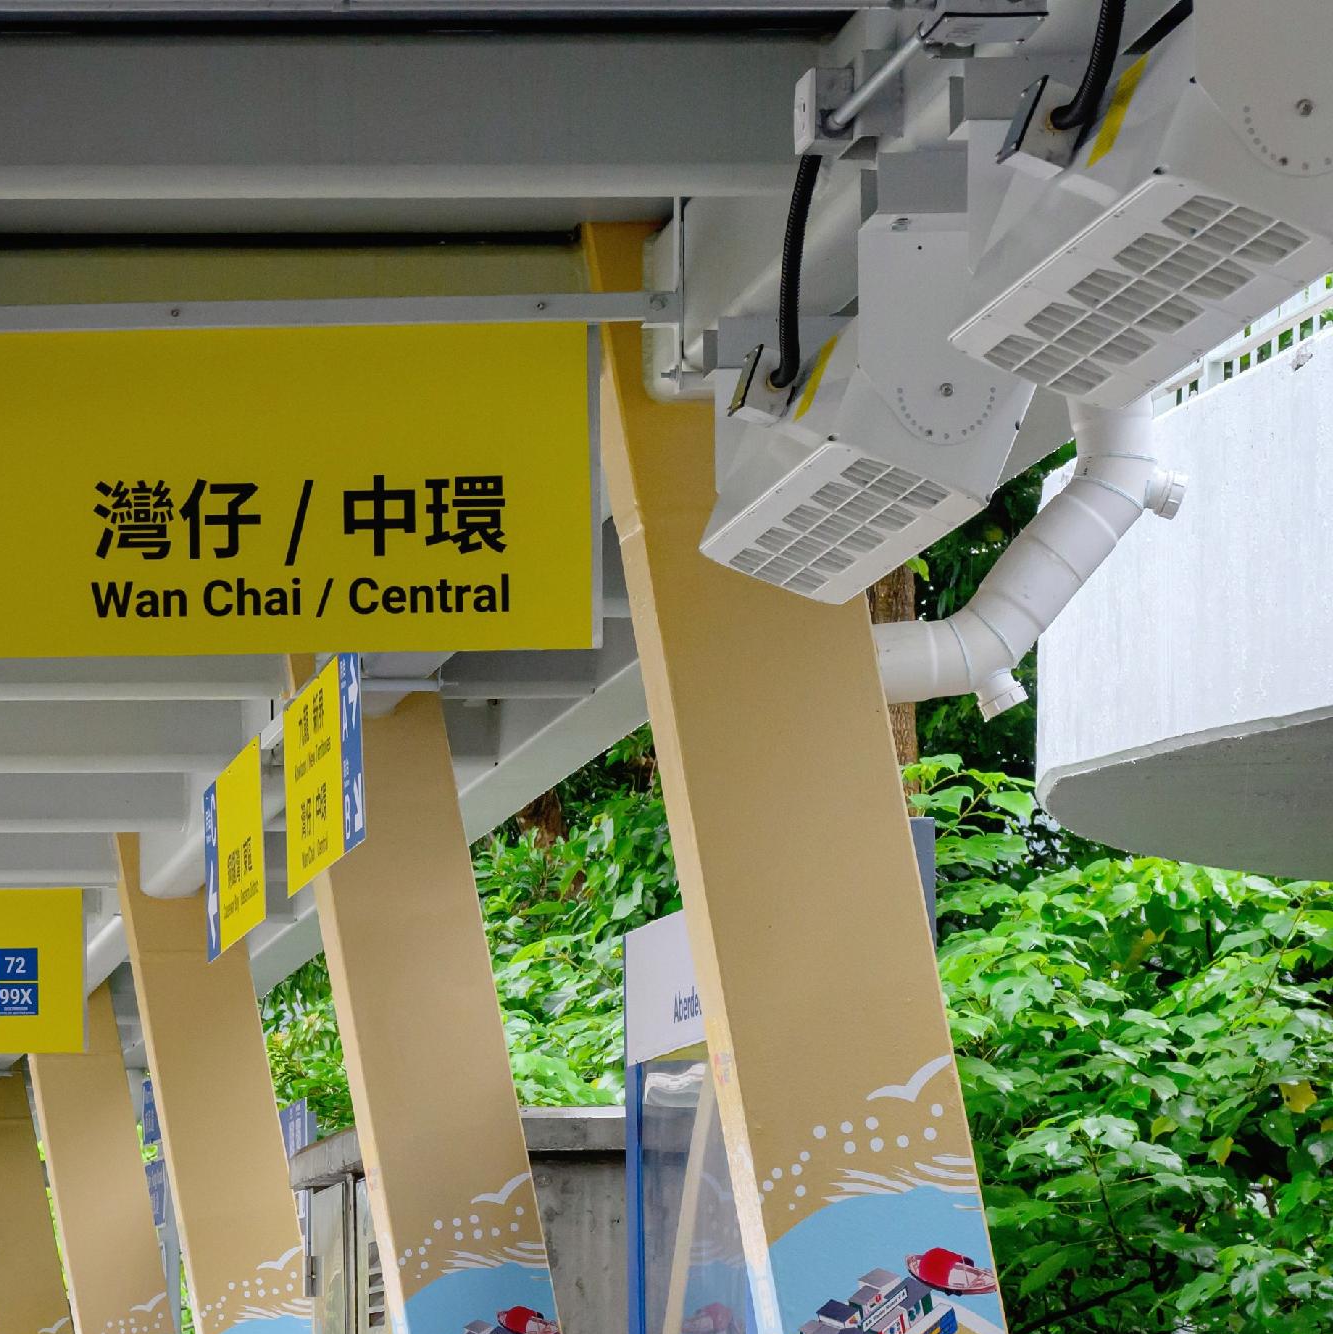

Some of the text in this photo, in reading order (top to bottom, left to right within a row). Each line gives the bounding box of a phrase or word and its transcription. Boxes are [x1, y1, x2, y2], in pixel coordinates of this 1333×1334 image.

[93, 473, 507, 567] 灣仔 / 中環
[91, 572, 511, 619] Wan Chai / Central
[4, 956, 26, 974] 72
[0, 988, 33, 1005] 99X
